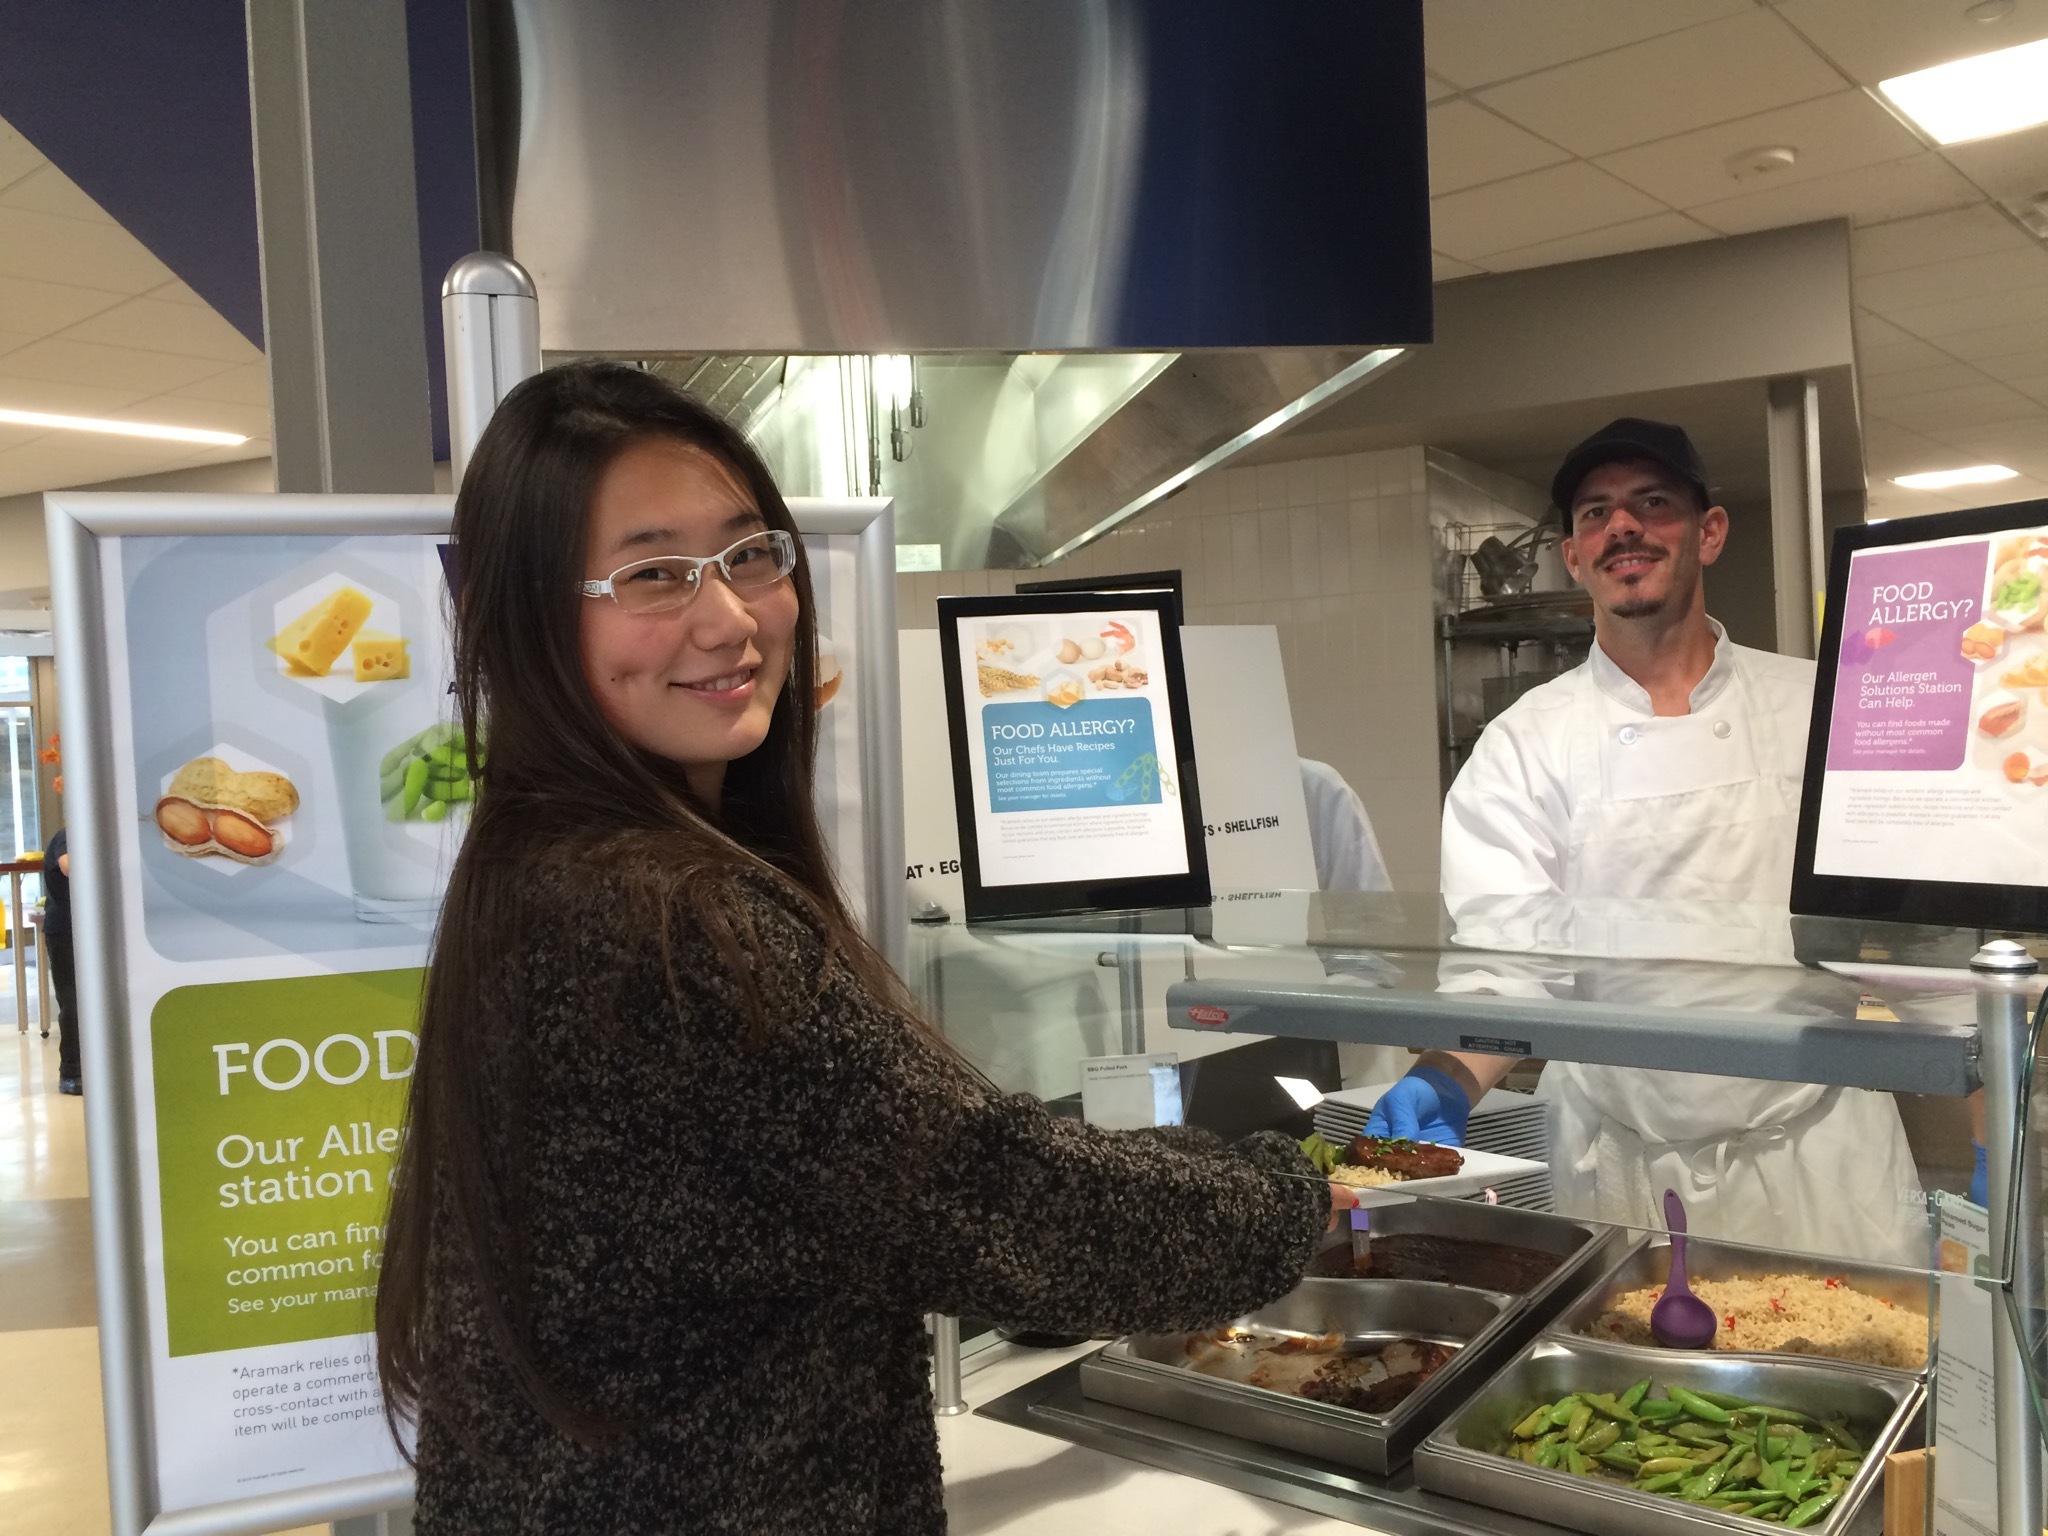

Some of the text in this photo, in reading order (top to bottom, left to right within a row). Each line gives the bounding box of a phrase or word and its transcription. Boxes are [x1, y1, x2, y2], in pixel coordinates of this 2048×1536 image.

[1872, 581, 1933, 604] FOOD
[1868, 599, 1974, 625] ALLERGY?
[1862, 671, 1937, 684] Our Allergen
[1860, 682, 1962, 696] Solutions Station
[1859, 697, 1915, 709] Can Help.
[991, 719, 1135, 740] FOOD ALLERGY?
[1855, 729, 1884, 737] without
[1904, 719, 1927, 727] foods
[993, 741, 1115, 756] Our Chefs Have Recipes
[994, 756, 1016, 766] Just
[1019, 755, 1035, 764] For
[996, 777, 1029, 786] selections
[1047, 775, 1085, 785] ingredients
[1086, 774, 1111, 782] without
[1010, 770, 1031, 779] dining
[1050, 769, 1079, 777] prepares
[1080, 767, 1102, 775] special
[997, 785, 1014, 793] most
[1046, 783, 1062, 791] food
[1224, 815, 1279, 834] SHELLFISH
[906, 859, 961, 880] AT EG
[212, 1029, 420, 1096] FOOD
[216, 1134, 304, 1169] Our
[219, 1166, 373, 1208] station
[224, 1235, 278, 1257] You
[286, 1230, 337, 1251] can
[226, 1249, 384, 1286] common fo
[228, 1285, 378, 1314] See your mana
[309, 1356, 349, 1371] relies
[354, 1353, 371, 1365] on
[232, 1370, 378, 1400] operate a commerci
[233, 1394, 334, 1418] cross-contact
[338, 1388, 368, 1403] with
[234, 1423, 267, 1437] item
[272, 1416, 297, 1431] will
[302, 1415, 319, 1427] be
